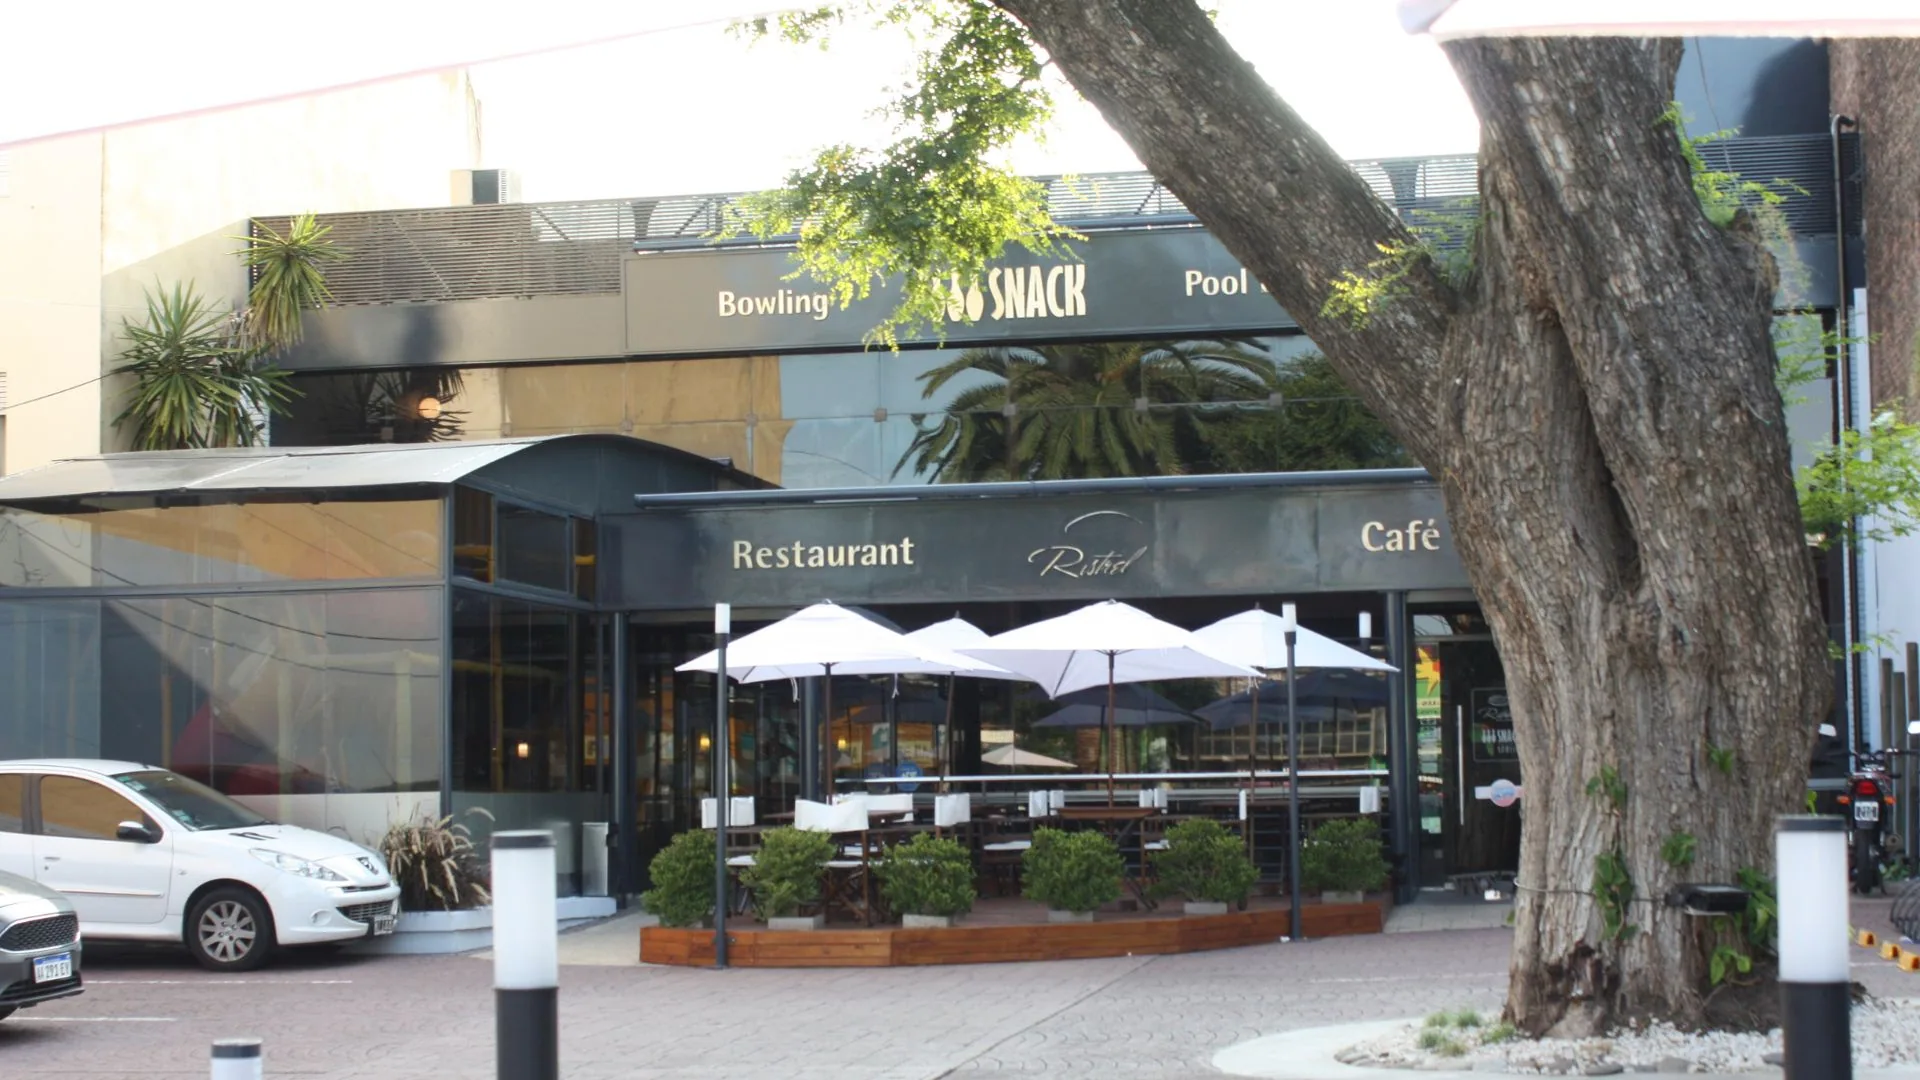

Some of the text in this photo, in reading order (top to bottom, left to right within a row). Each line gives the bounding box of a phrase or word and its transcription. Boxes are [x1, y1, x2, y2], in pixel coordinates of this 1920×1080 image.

[988, 264, 1086, 321] SNACK
[1185, 267, 1247, 296] Pool
[718, 289, 829, 321] Bowling
[1361, 518, 1441, 552] Café
[733, 536, 915, 569] Restaurant
